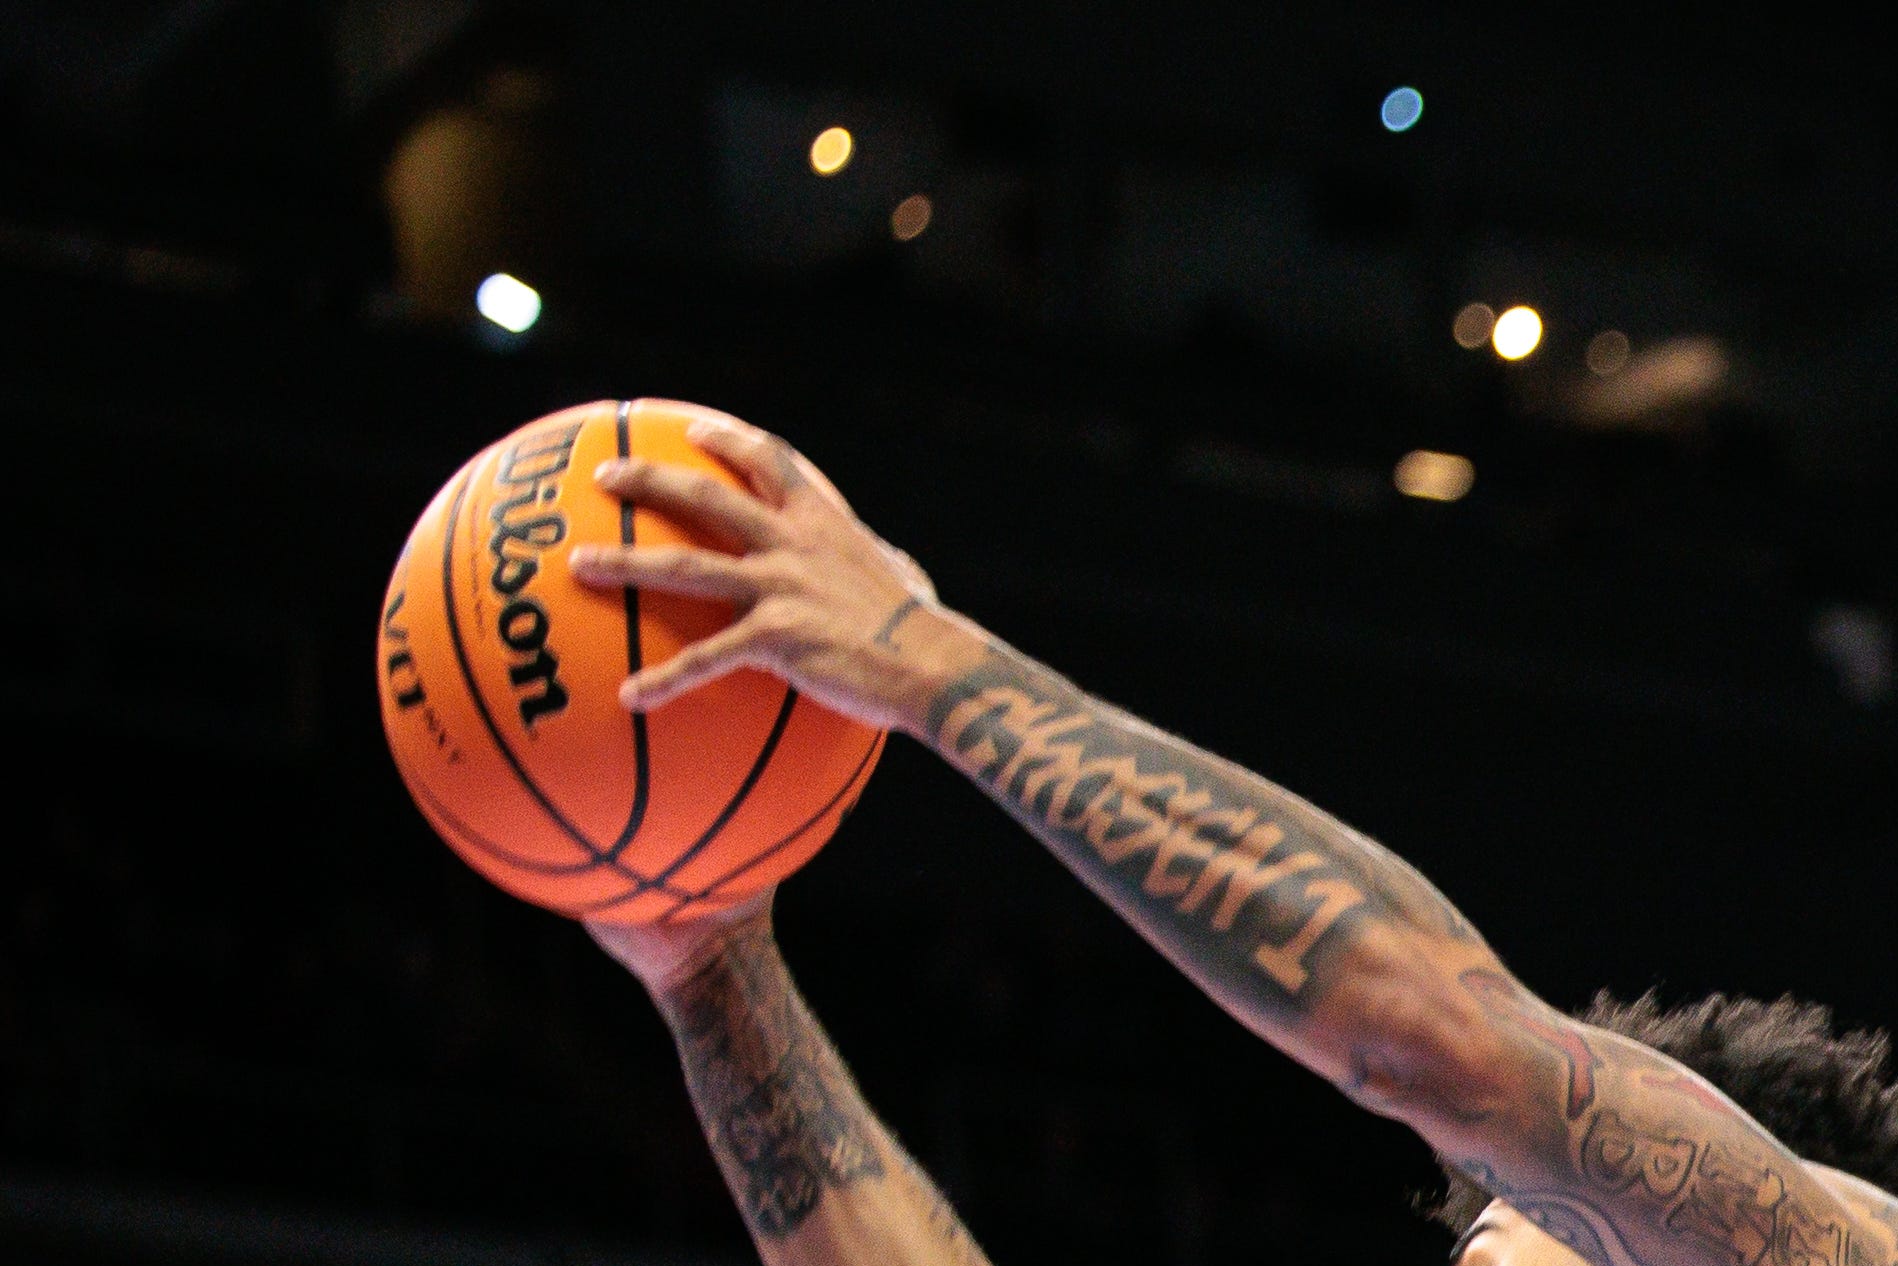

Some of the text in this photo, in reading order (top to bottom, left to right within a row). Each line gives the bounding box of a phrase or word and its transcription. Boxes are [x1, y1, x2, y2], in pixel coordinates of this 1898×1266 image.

[489, 421, 584, 732] Wilson
[939, 686, 1366, 993] CHOSEN 1
